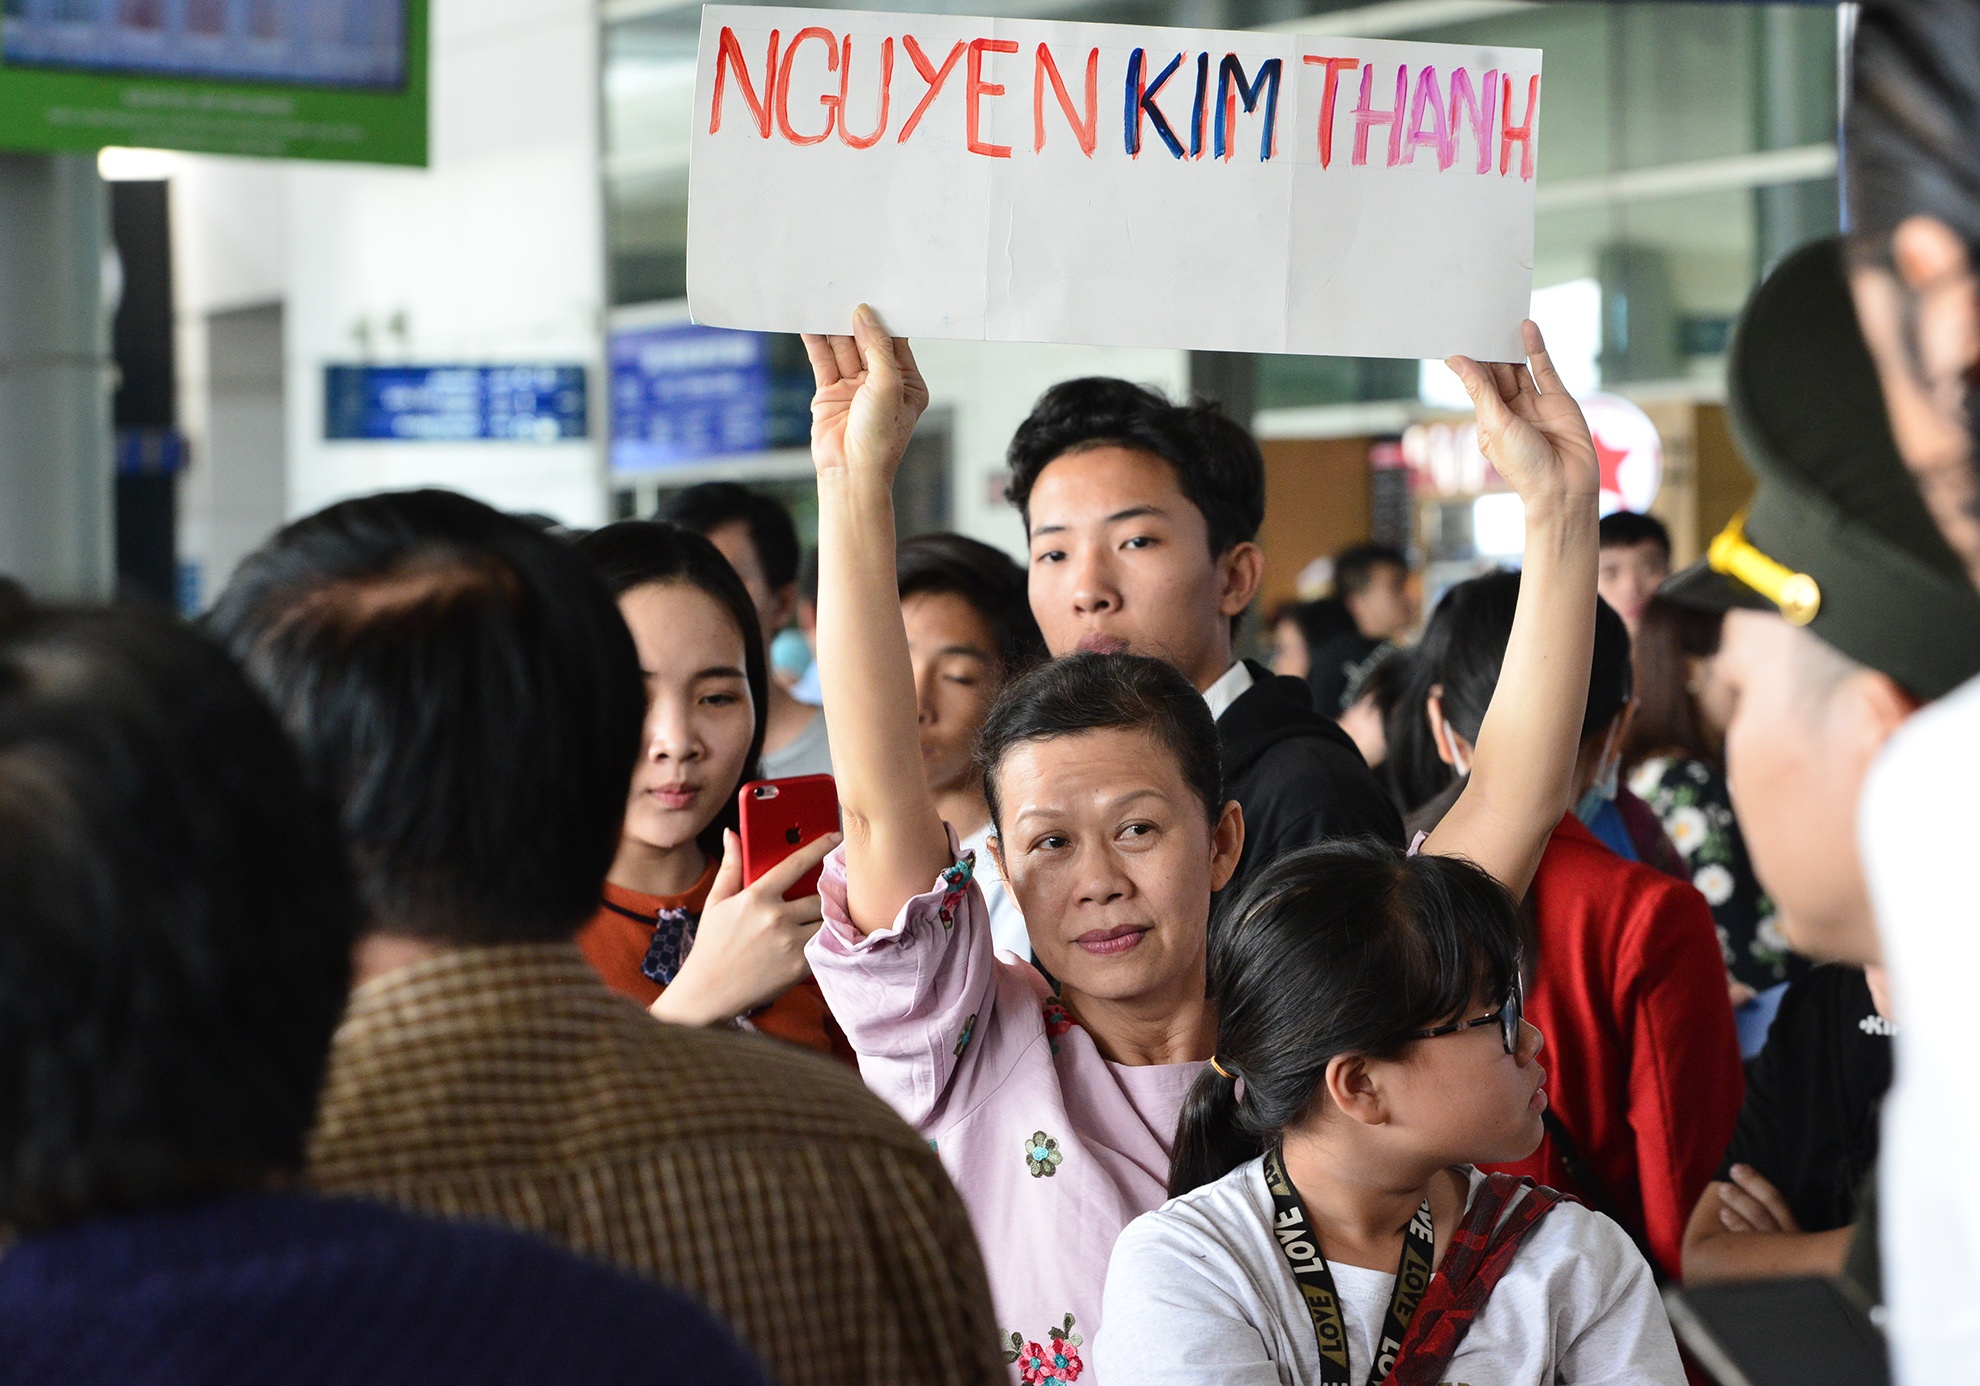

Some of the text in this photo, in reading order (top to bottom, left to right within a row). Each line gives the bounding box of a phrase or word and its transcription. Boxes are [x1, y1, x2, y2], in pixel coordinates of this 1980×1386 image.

[710, 26, 1539, 182] NGUYEN KIM THANH
[1274, 1206, 1324, 1274] LOVE
[1307, 1296, 1342, 1353] LOVE
